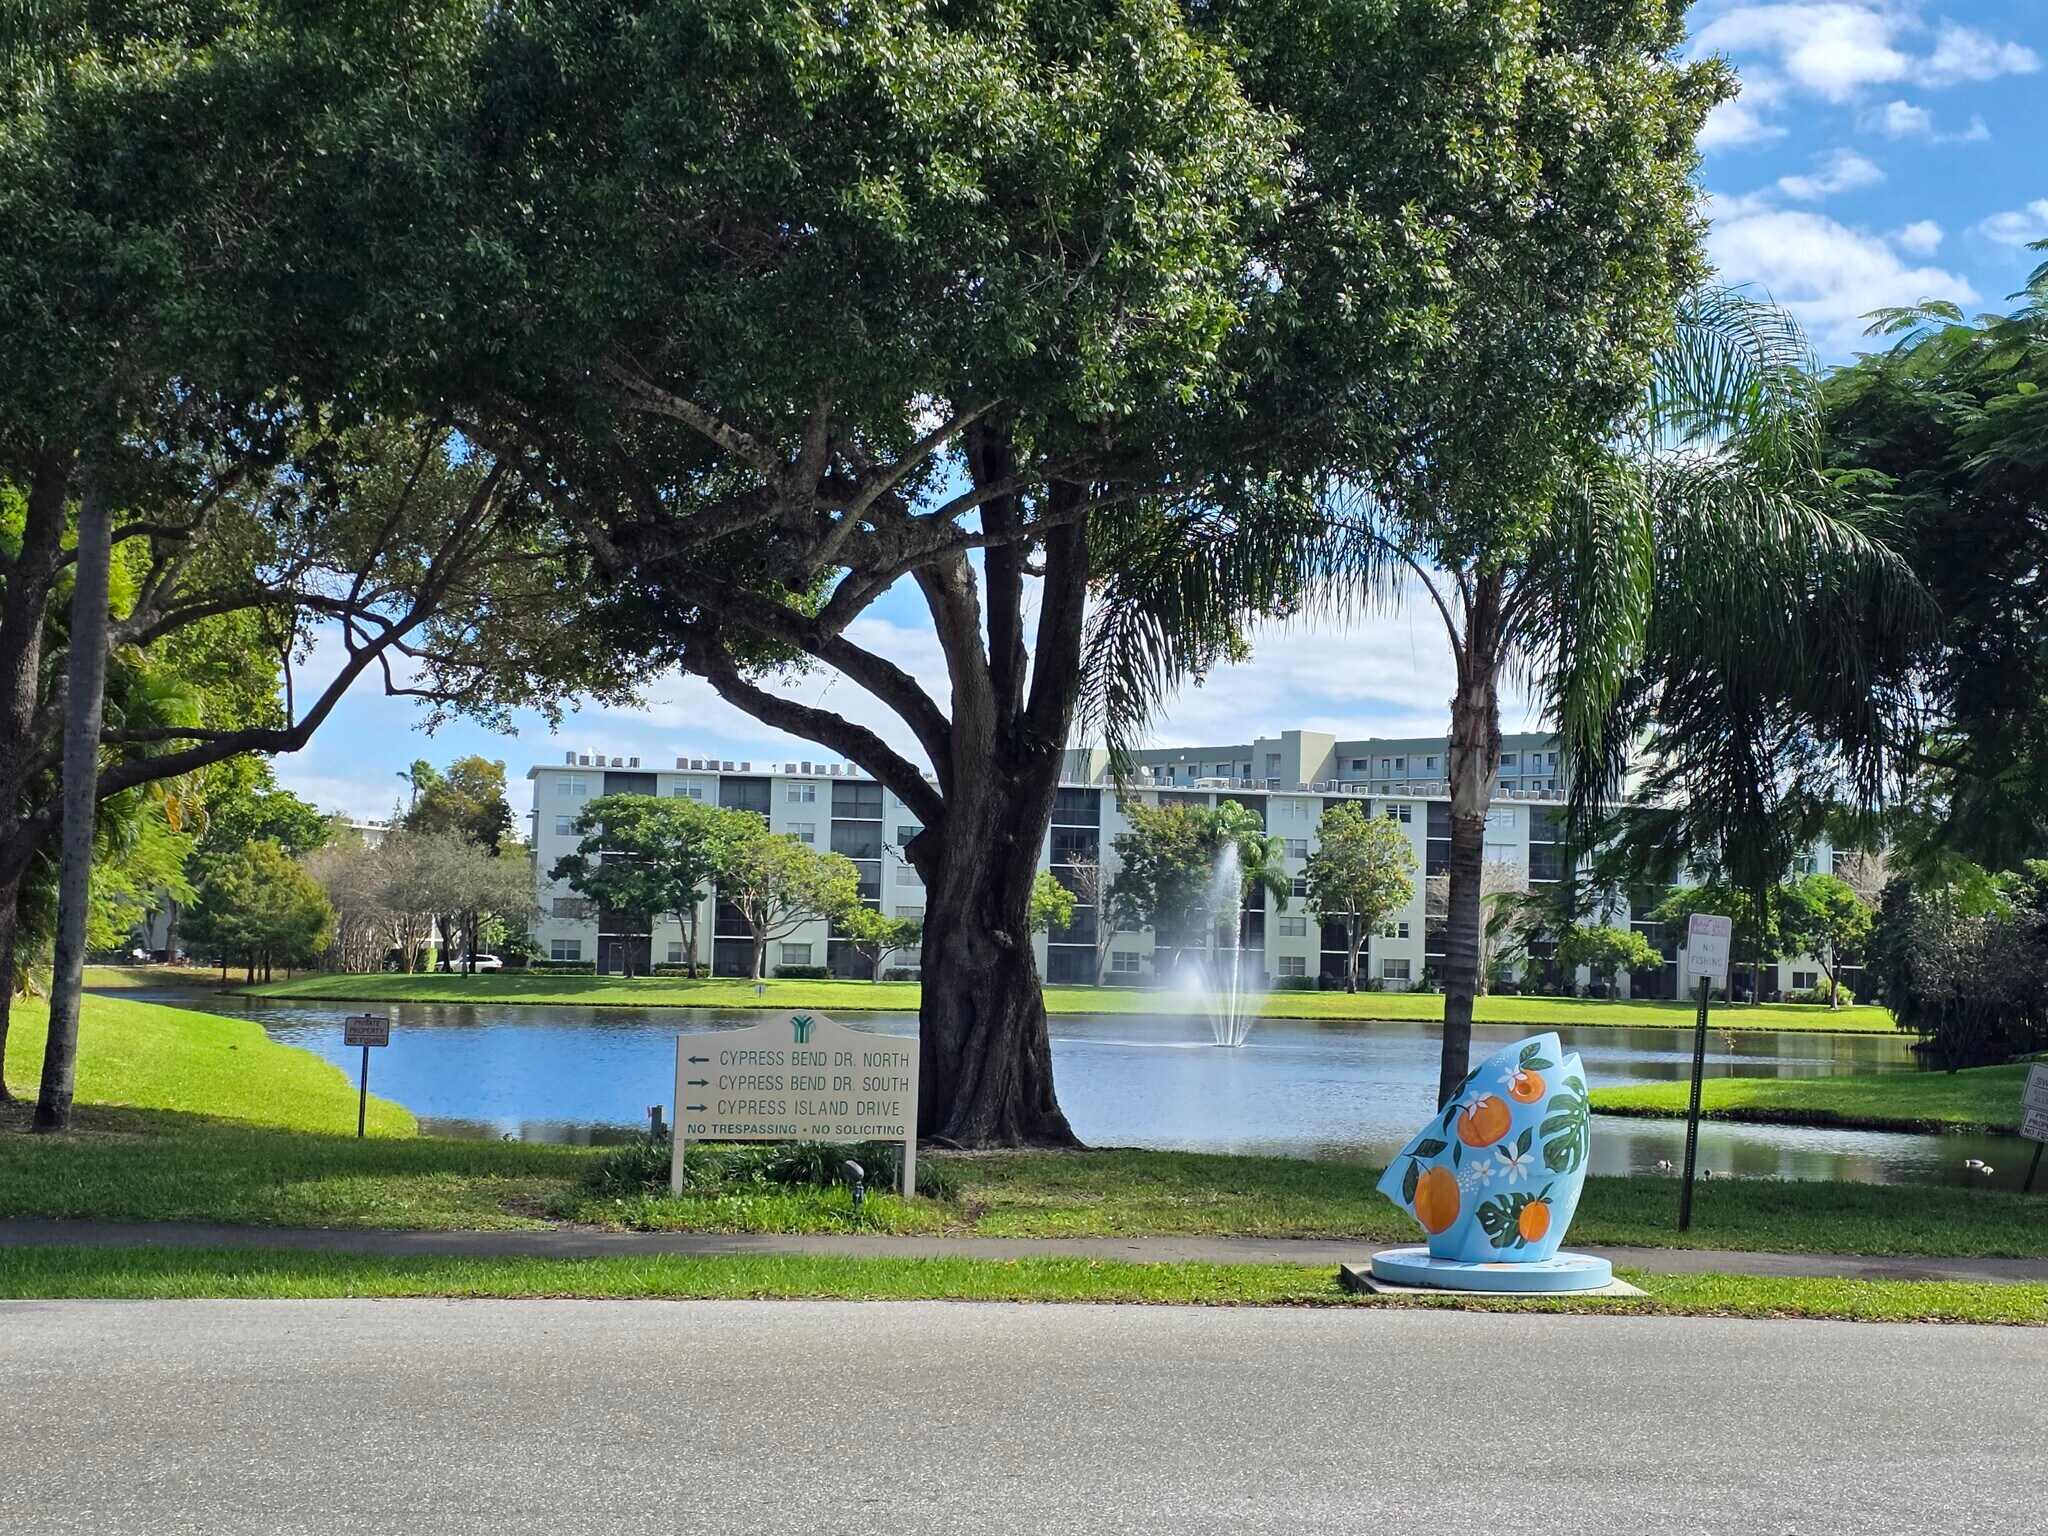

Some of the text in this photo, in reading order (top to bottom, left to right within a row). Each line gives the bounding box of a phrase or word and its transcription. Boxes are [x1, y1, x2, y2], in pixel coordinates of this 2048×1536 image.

[1702, 943, 1714, 953] NO
[1691, 956, 1723, 966] FISHING
[720, 1050, 909, 1068] CYPRESS BEND DR. NORTH
[719, 1075, 909, 1092] CYPRESS BEND DR. SOUTH
[717, 1100, 900, 1117] CYPRESS ISLAND DRIVE
[687, 1124, 905, 1136] NO TRESPASSING NO SOLICITING
[2024, 1127, 2034, 1135] NO
